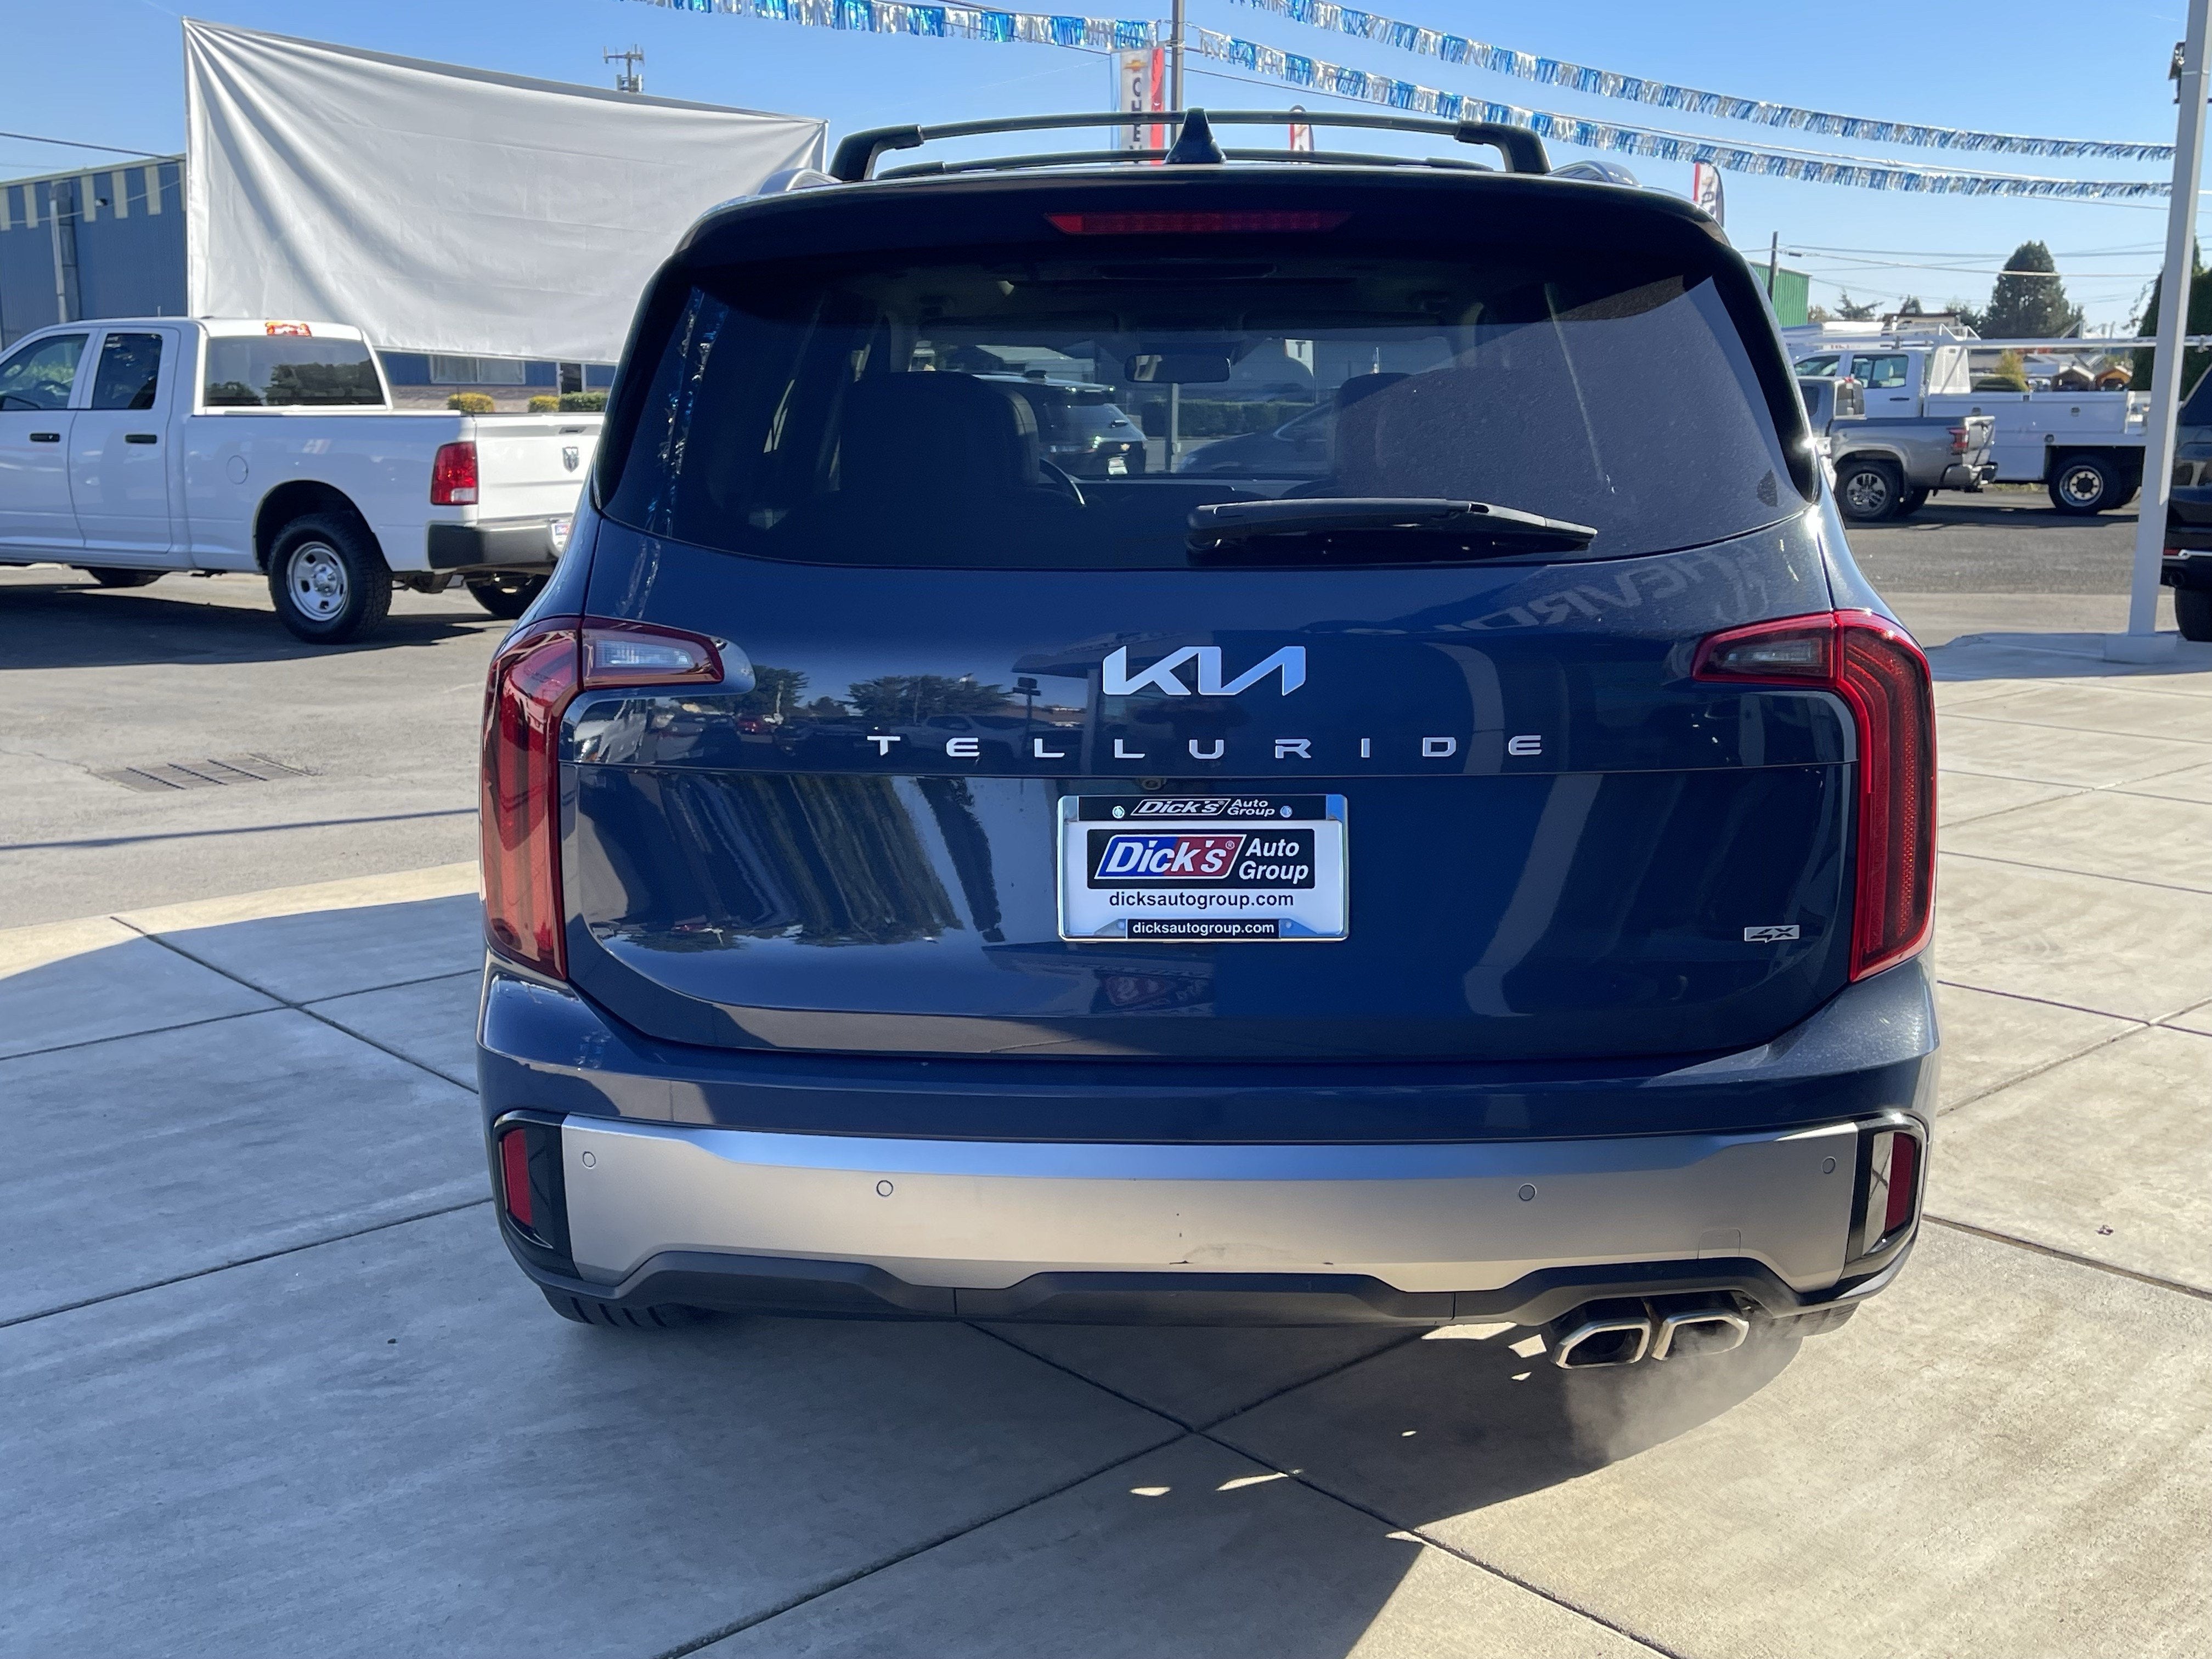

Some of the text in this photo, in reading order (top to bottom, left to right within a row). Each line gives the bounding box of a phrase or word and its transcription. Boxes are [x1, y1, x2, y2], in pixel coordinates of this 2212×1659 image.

[1103, 645, 1306, 696] KIA
[867, 734, 1543, 759] TELLURIDE
[1138, 800, 1220, 813] Dick's
[1227, 806, 1275, 816] Group
[1231, 799, 1268, 808] Auto
[1105, 839, 1226, 873] Dick's
[1245, 838, 1300, 857] Auto
[1238, 861, 1309, 884] Group
[1109, 891, 1294, 910] dicksautogroup.com
[1132, 921, 1275, 935] dicksautogroup.com
